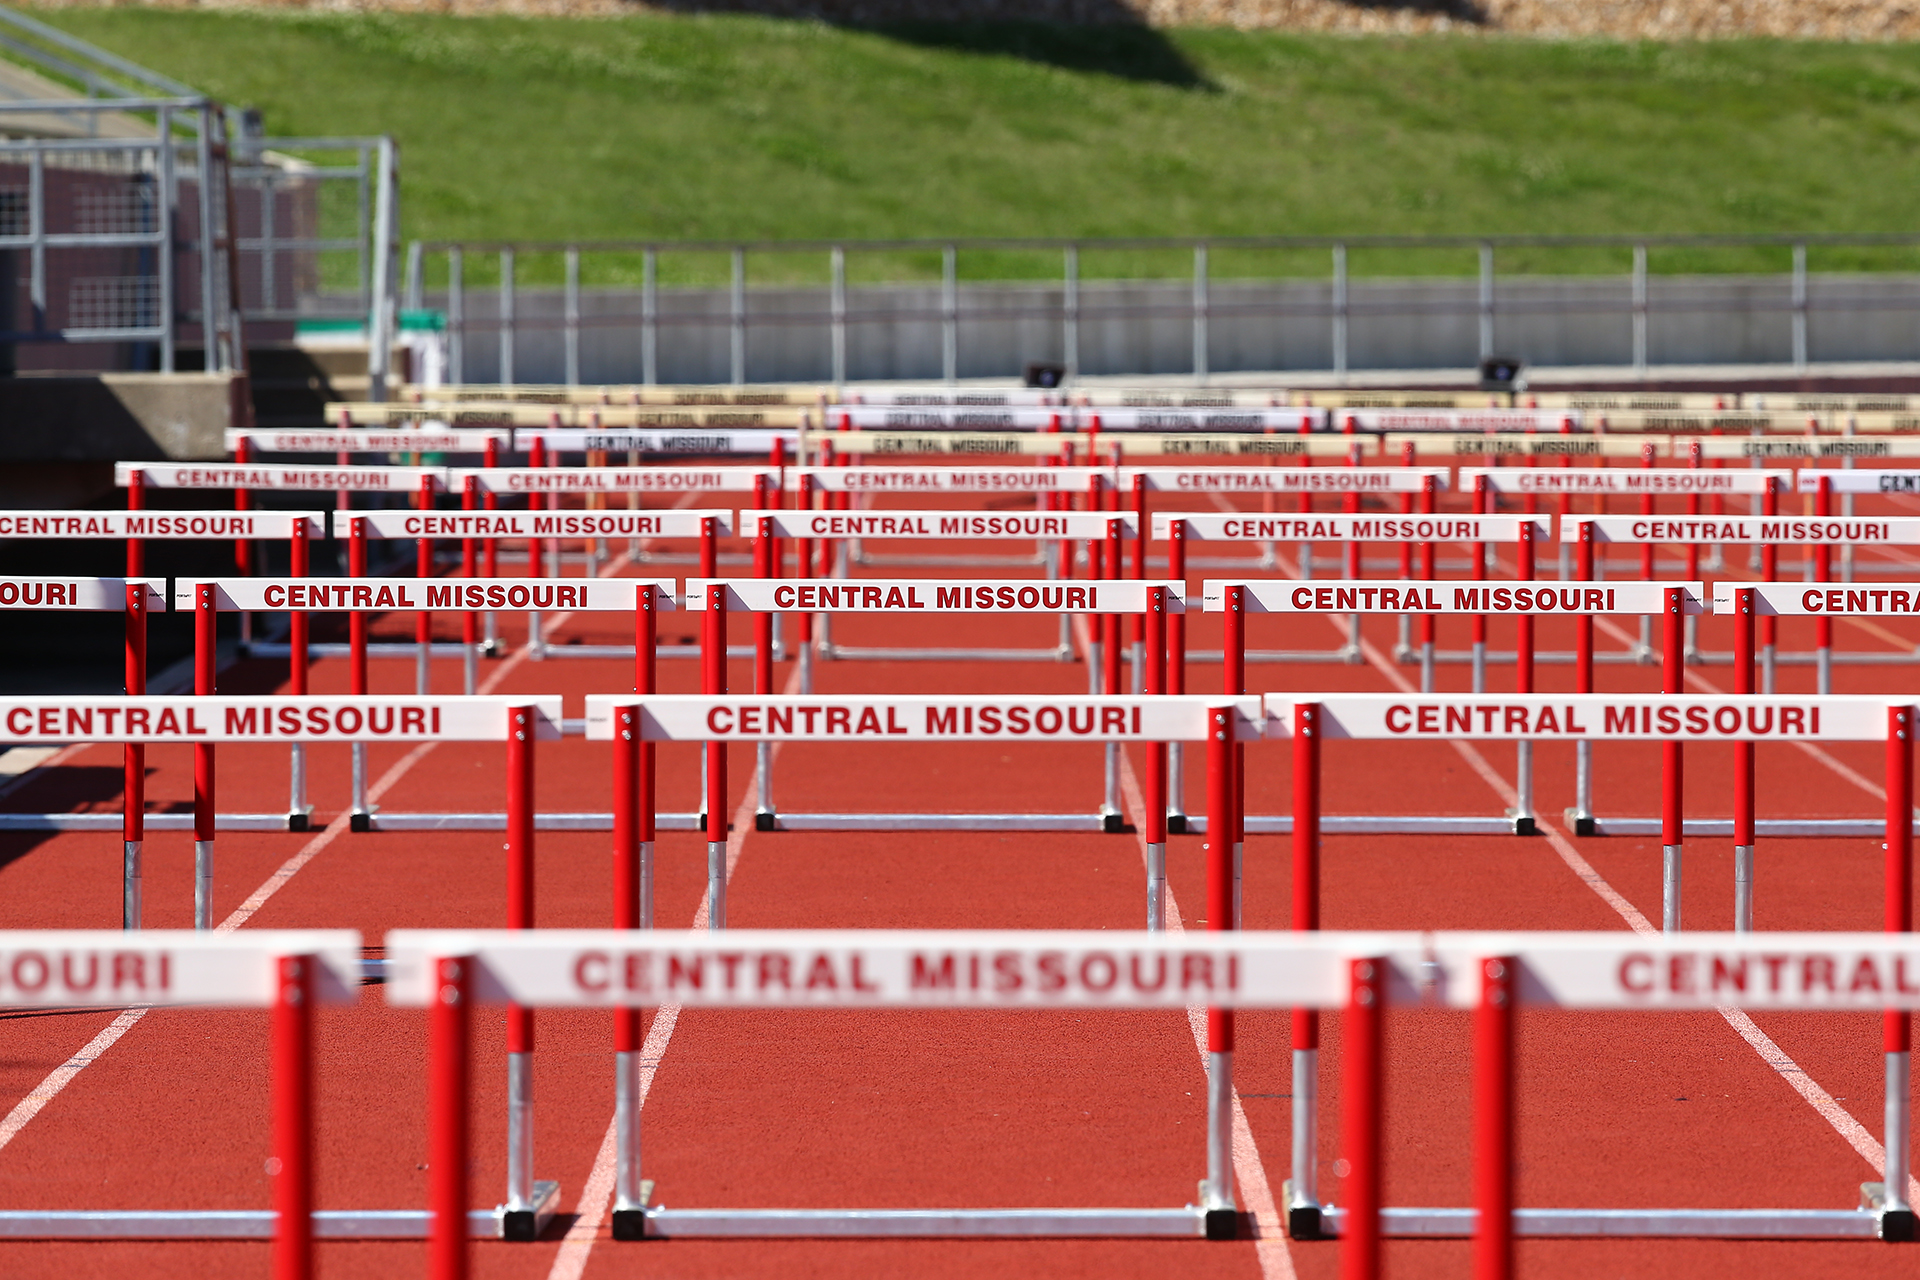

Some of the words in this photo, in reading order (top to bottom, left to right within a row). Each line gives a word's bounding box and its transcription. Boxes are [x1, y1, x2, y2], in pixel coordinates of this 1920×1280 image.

[175, 470, 274, 487] CENTRAL
[283, 472, 389, 489] MISSOURI
[508, 474, 607, 491] CENTRAL
[615, 473, 722, 491] MISSOURI
[844, 473, 941, 491] CENTRAL
[951, 473, 1057, 491] MISSOURI
[1176, 473, 1274, 492] CENTRAL
[1284, 473, 1390, 492] MISSOURI
[1518, 475, 1616, 493] CENTRAL
[1626, 475, 1733, 494] MISSOURI
[0, 518, 115, 534] CENTRAL
[126, 517, 253, 535] MISSOURI
[404, 517, 524, 534] CENTRAL
[534, 517, 661, 534] MISSOURI
[811, 517, 930, 534] CENTRAL
[940, 517, 1068, 535] MISSOURI
[1223, 520, 1342, 538] CENTRAL
[1352, 520, 1480, 538] MISSOURI
[1631, 522, 1751, 539] CENTRAL
[1761, 522, 1889, 540] MISSOURI
[263, 584, 415, 607] CENTRAL
[427, 584, 588, 608] MISSOURI
[774, 585, 925, 608] CENTRAL
[937, 586, 1097, 609] MISSOURI
[1291, 587, 1442, 610] CENTRAL
[1454, 587, 1615, 611] MISSOURI
[6, 706, 207, 735] CENTRAL
[224, 706, 441, 735] MISSOURI
[706, 705, 908, 734] CENTRAL
[925, 705, 1141, 735] MISSOURI
[1384, 704, 1586, 733] CENTRAL
[1603, 705, 1820, 734] MISSOURI
[572, 950, 878, 992] CENTRAL
[908, 951, 1240, 993] MISSOURI
[1616, 952, 1920, 993] CENTRAL
